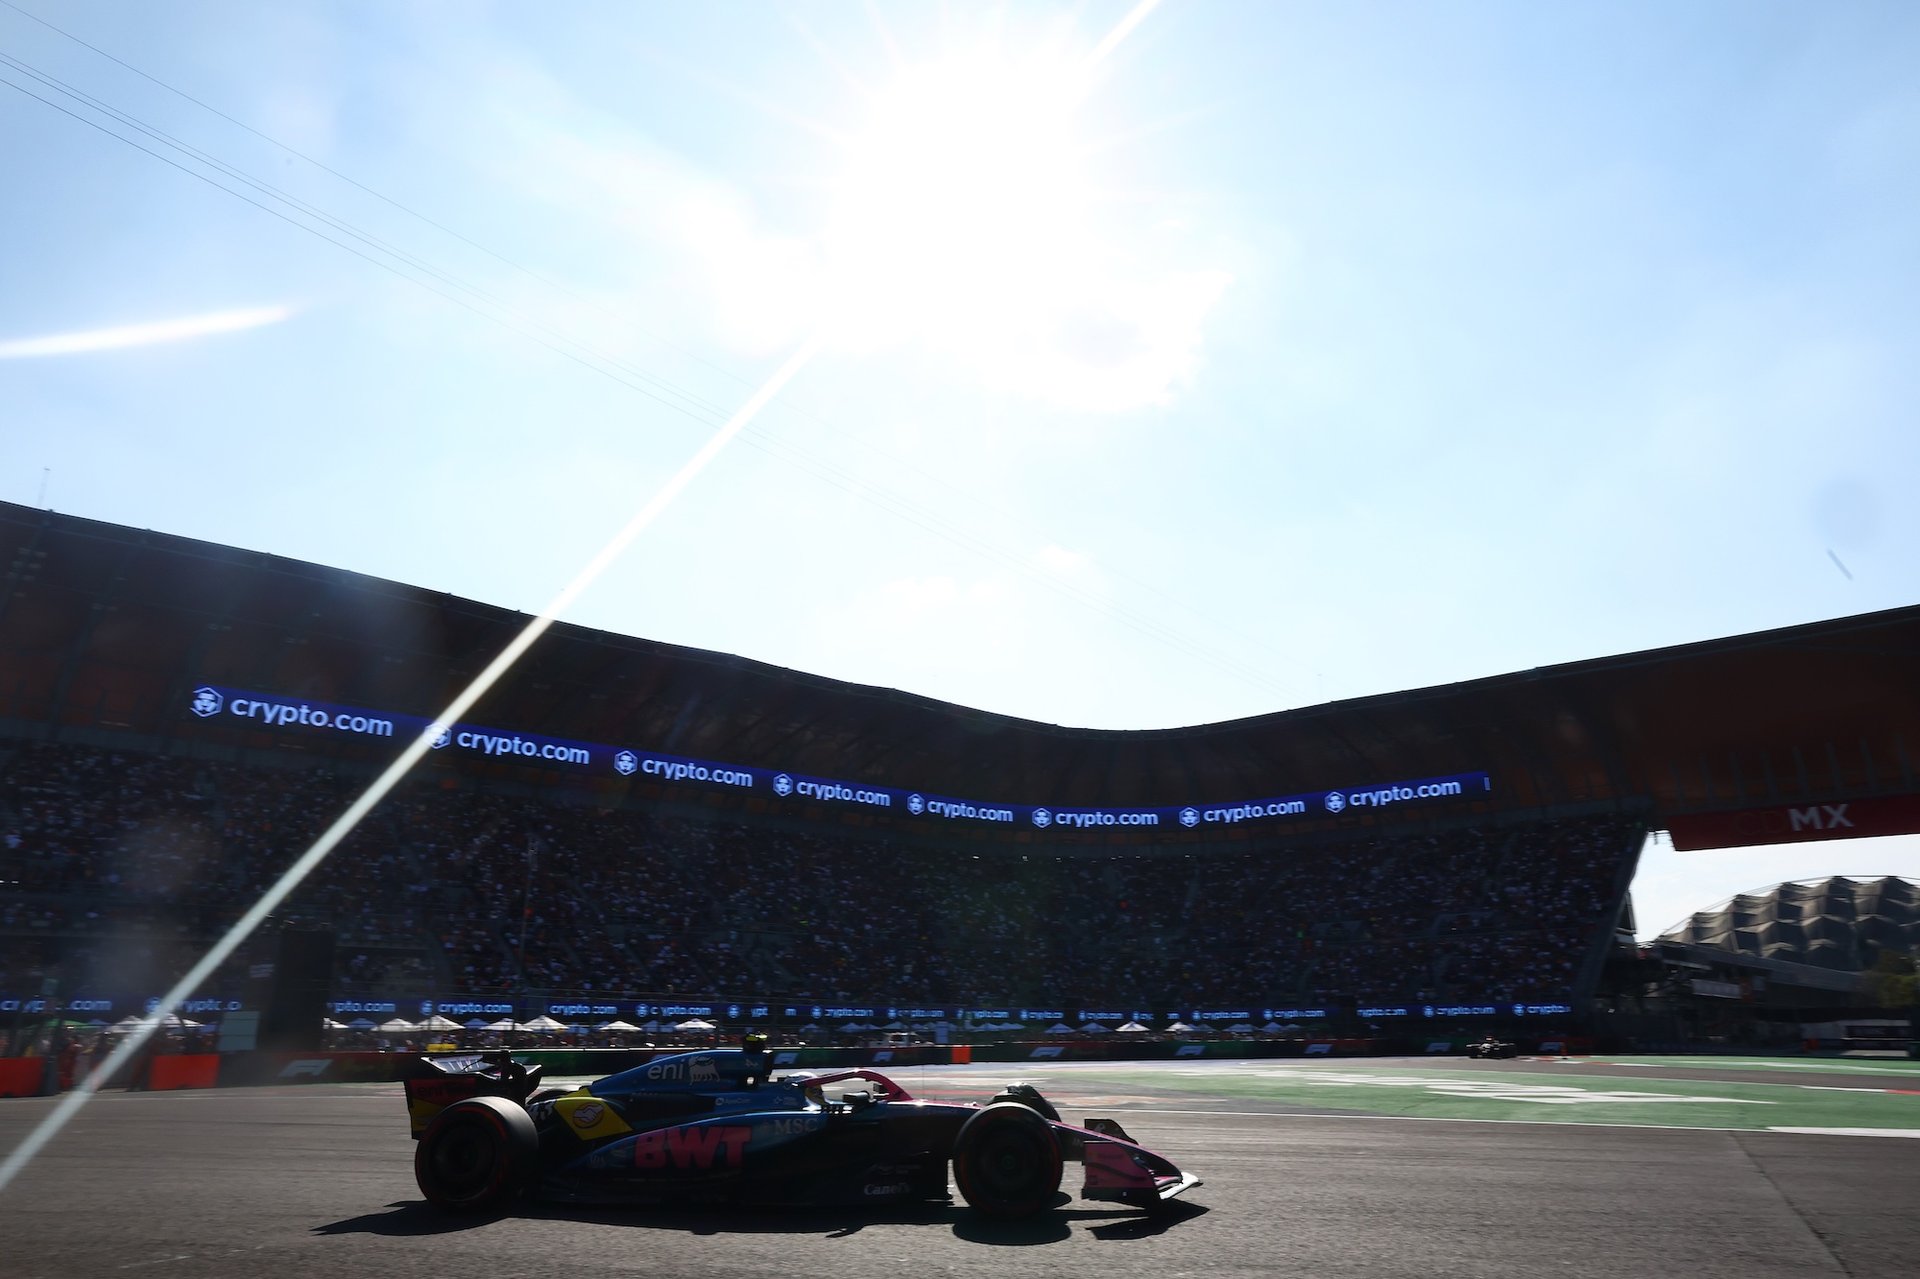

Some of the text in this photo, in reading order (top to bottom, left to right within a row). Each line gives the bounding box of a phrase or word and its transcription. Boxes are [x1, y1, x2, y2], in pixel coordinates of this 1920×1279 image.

[230, 698, 393, 737] crypto.com
[457, 730, 590, 764] crypto.com
[641, 758, 753, 787] crypto.com
[796, 781, 890, 806] crypto.com
[1349, 781, 1462, 806] crypto.com
[927, 800, 1014, 822] crypto.com
[1055, 811, 1159, 828] crypto.com
[1204, 800, 1306, 823] crypto.com
[437, 1003, 512, 1014] crypto.com
[650, 1006, 711, 1017] cypto.com
[647, 1058, 683, 1080] eni
[773, 1118, 818, 1135] MSC
[634, 1126, 752, 1168] BWT
